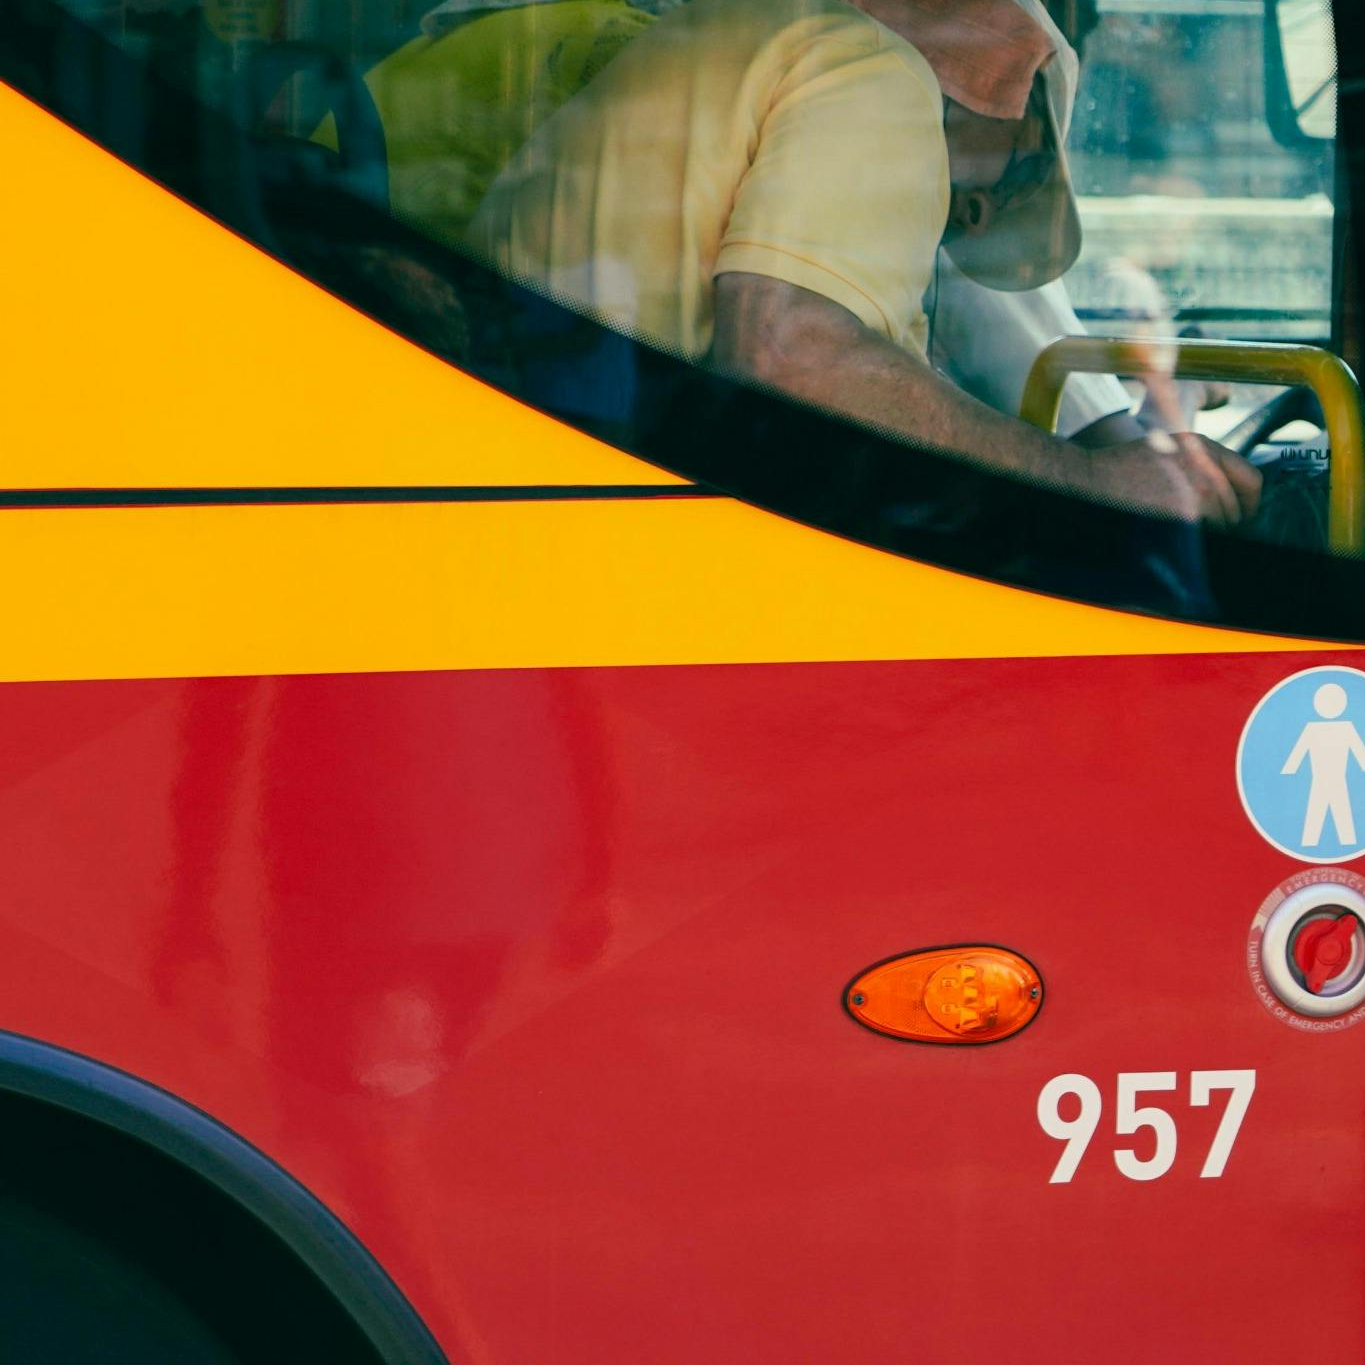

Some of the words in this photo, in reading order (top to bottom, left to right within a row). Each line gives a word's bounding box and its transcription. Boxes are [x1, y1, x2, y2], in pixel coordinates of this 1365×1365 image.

[1248, 940, 1259, 967] TURN
[1251, 970, 1262, 983] IN
[1257, 984, 1275, 1008] CASE
[1274, 1006, 1287, 1019] OF
[1288, 1015, 1346, 1032] EMERGENCY
[1035, 1068, 1257, 1185] 957
